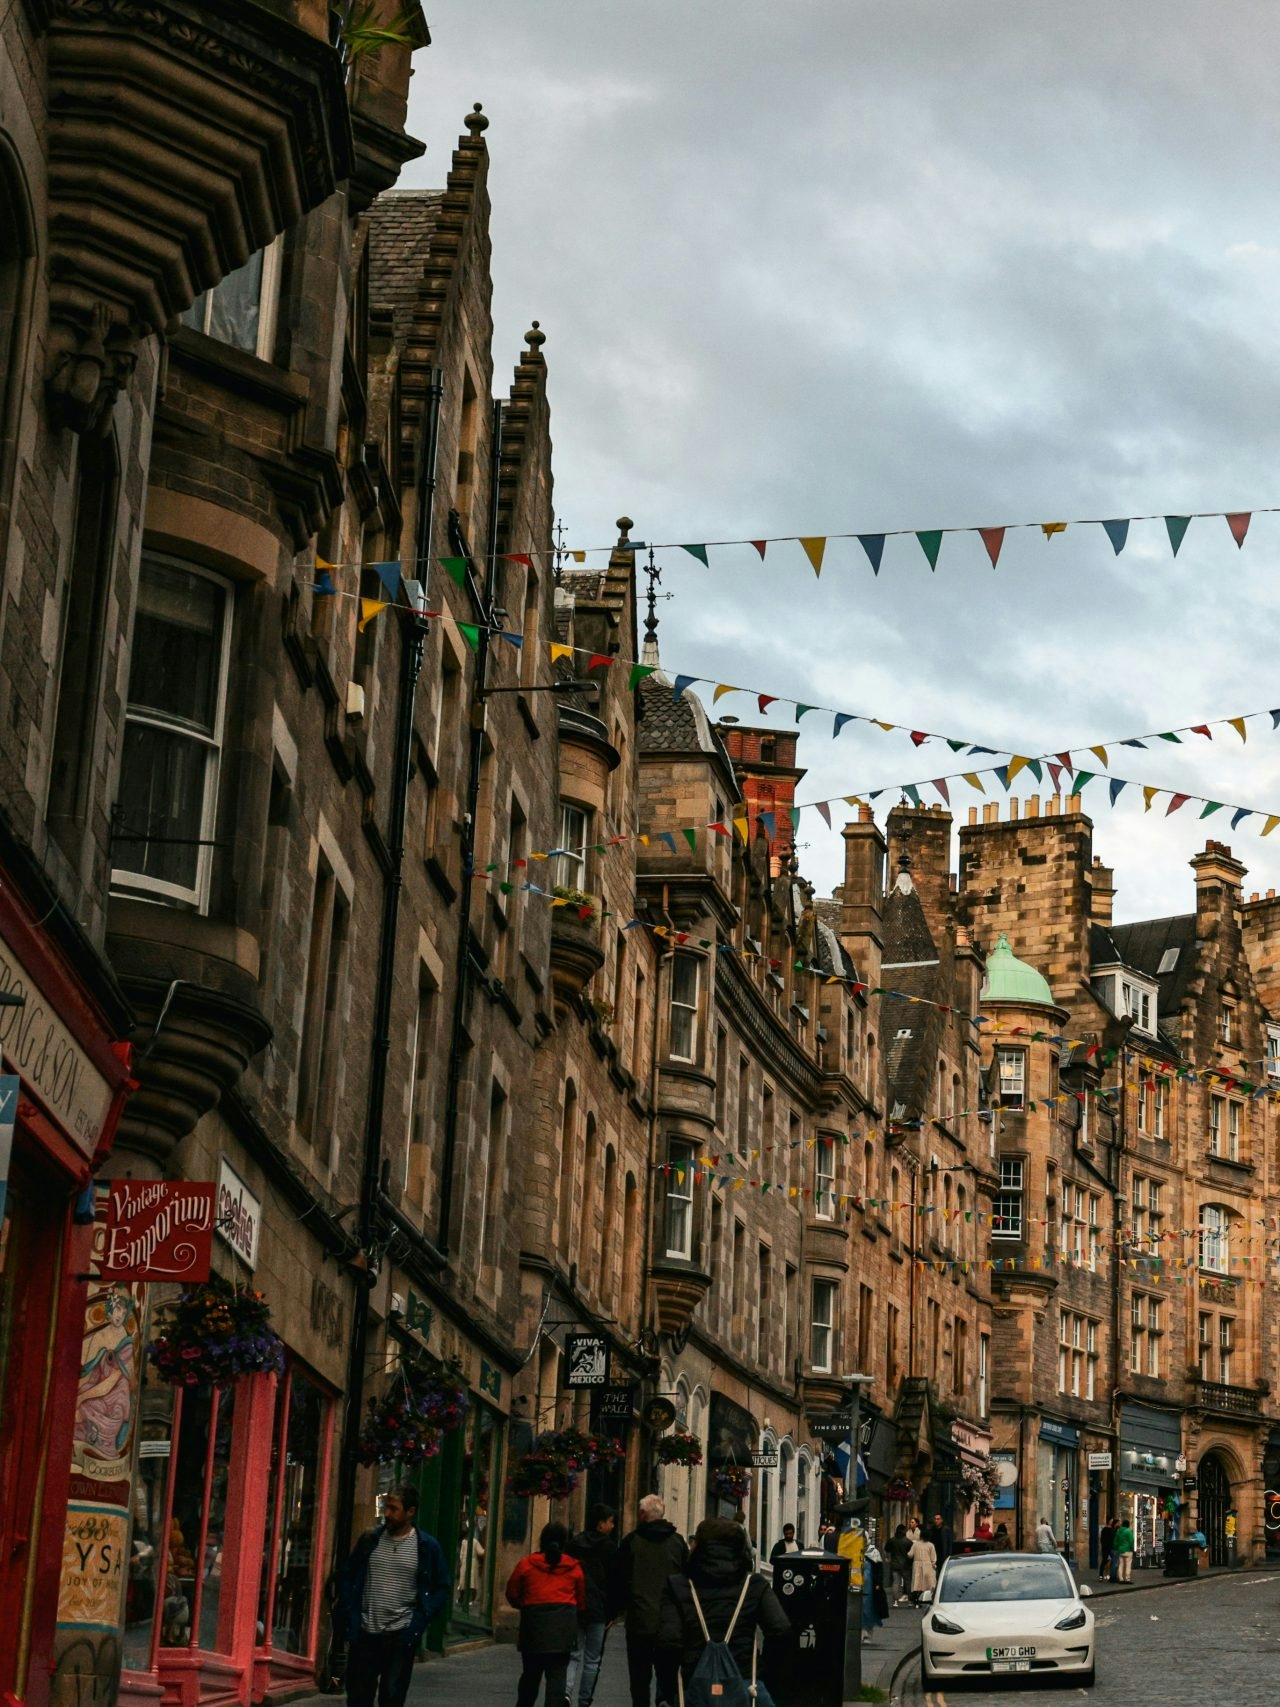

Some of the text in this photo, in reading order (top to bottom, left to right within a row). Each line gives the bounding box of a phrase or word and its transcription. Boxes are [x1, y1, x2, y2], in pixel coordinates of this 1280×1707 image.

[113, 1183, 168, 1223] Vintage
[105, 1191, 211, 1273] Emporium
[576, 1338, 600, 1346] VIVA
[568, 1376, 605, 1385] MEXICO
[752, 1456, 777, 1466] TIQUES
[993, 1646, 1036, 1657] SM70 GHD
